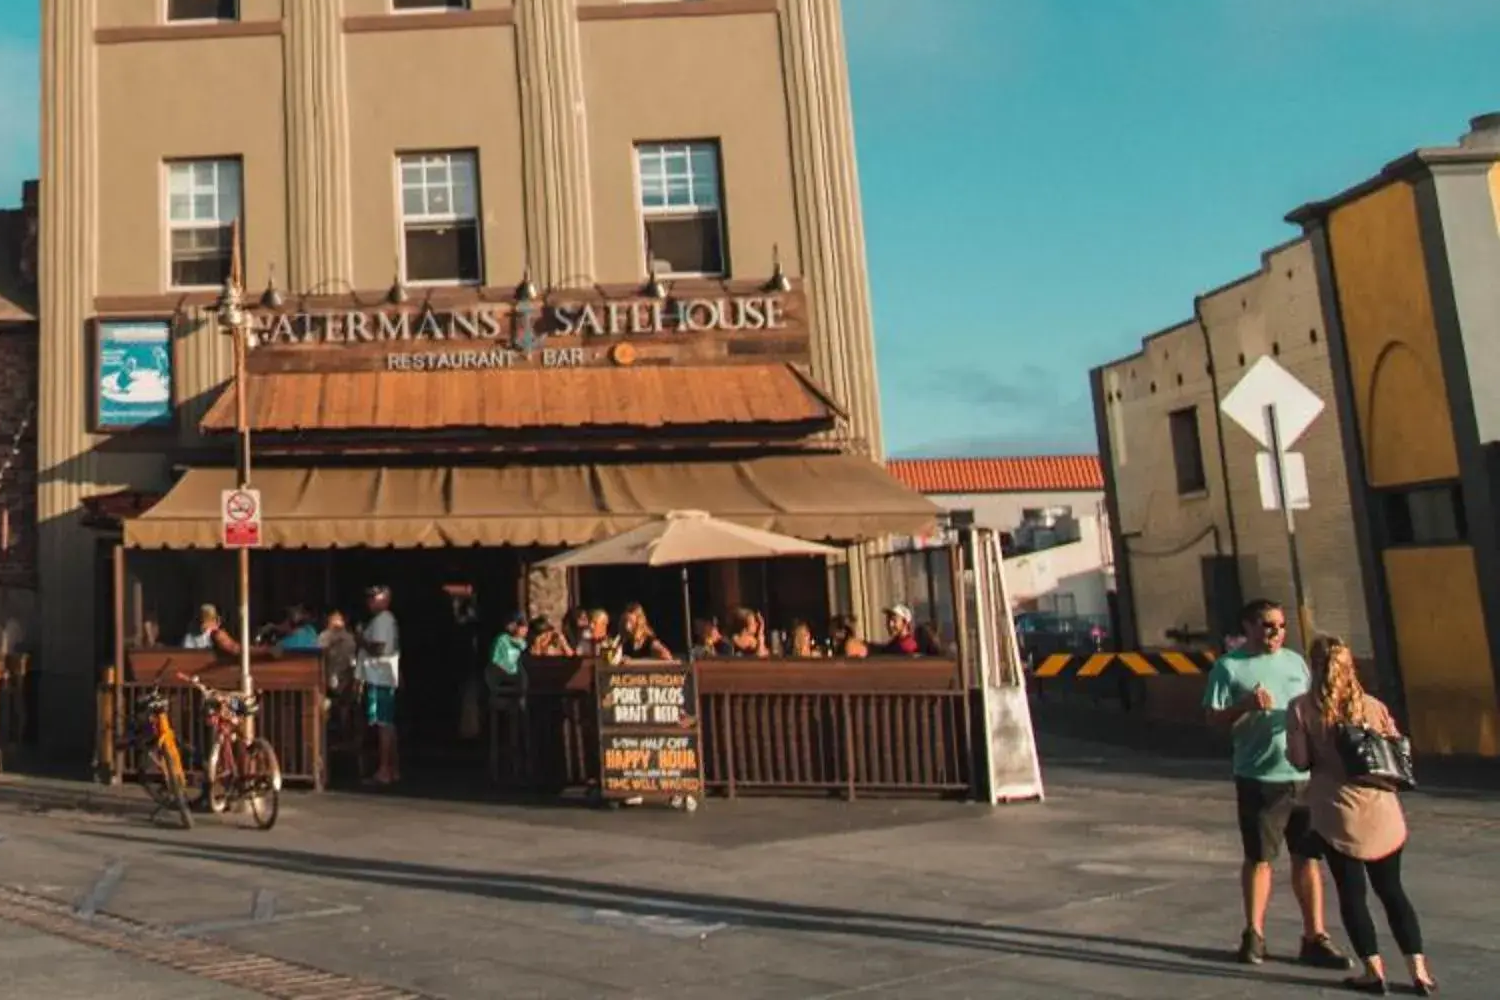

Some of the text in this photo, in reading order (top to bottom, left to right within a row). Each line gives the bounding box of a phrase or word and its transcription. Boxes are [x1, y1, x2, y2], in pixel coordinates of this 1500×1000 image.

[554, 297, 787, 335] SAFEHOUSE
[387, 349, 584, 371] RESTAURANT BAR
[646, 685, 685, 705] TACOS
[605, 748, 697, 770] HAPPY HOUR
